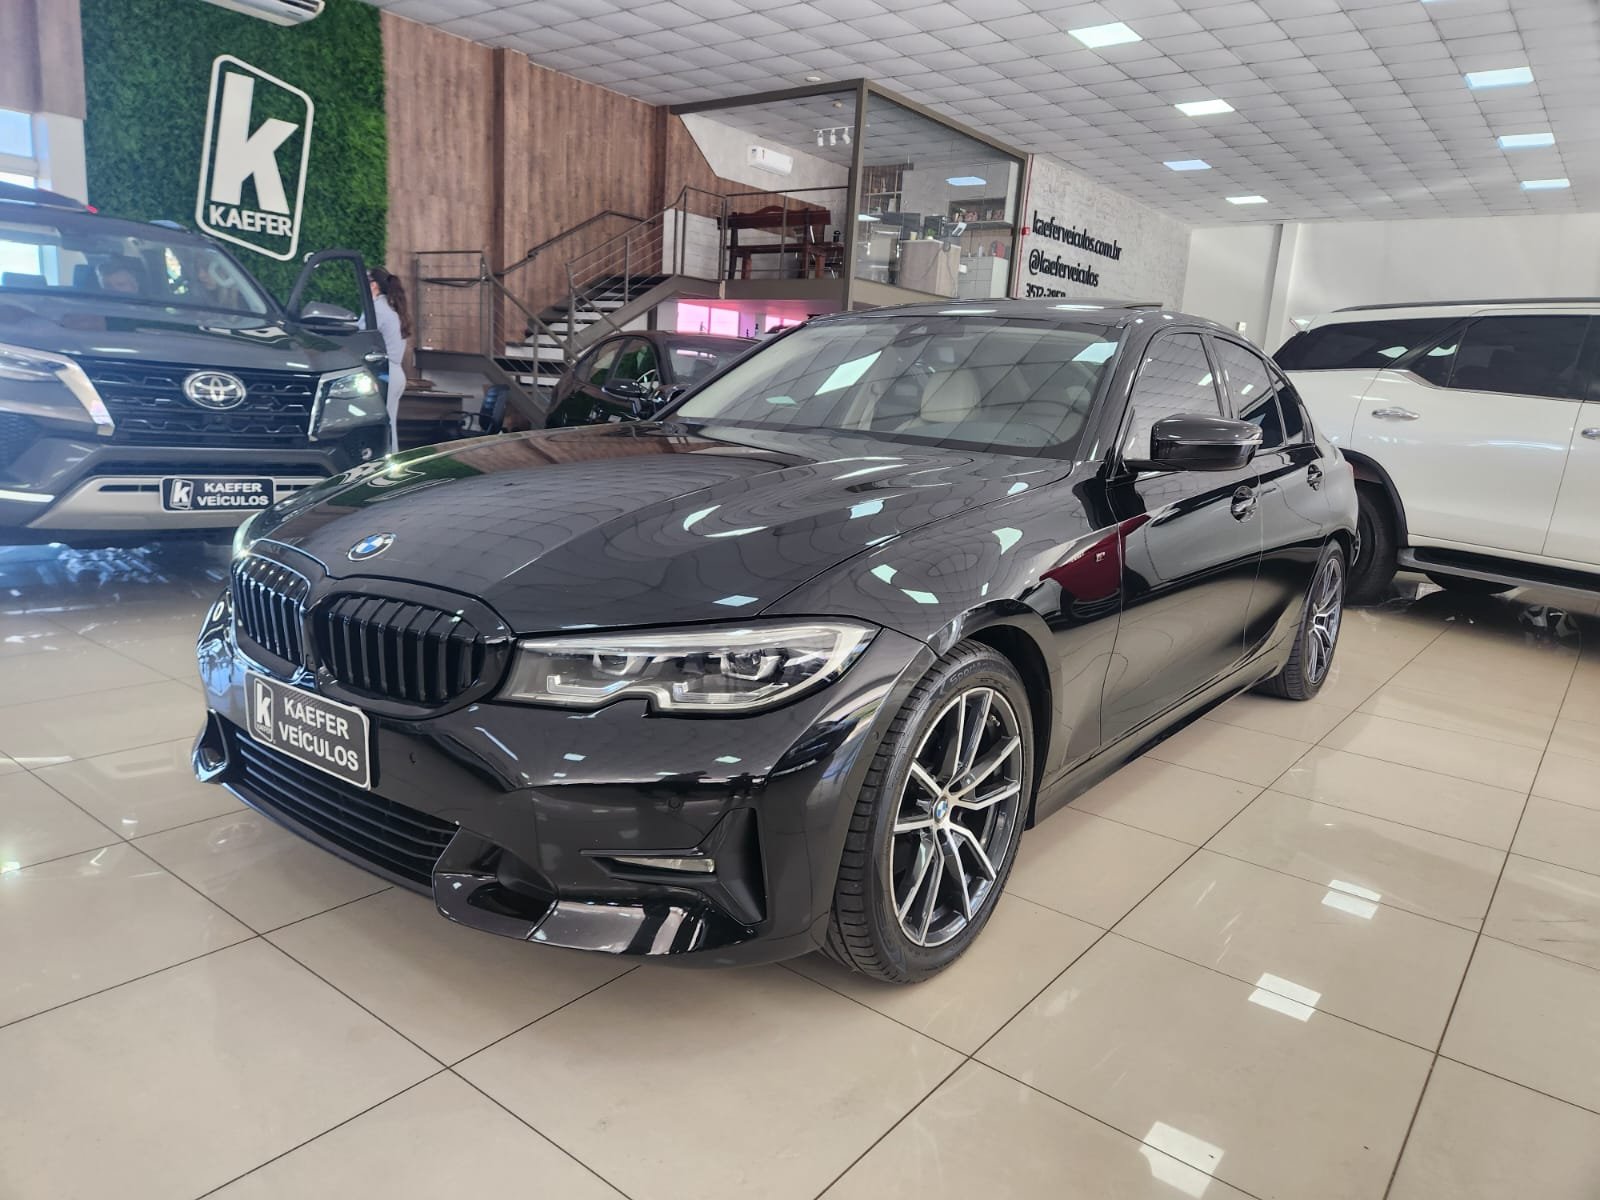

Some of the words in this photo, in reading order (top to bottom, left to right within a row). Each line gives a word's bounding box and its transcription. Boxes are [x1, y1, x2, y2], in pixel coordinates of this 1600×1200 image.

[209, 204, 293, 237] KAEFER
[1033, 210, 1122, 260] kaeferveiculos.com.br
[1029, 249, 1099, 287] @kaeferveiculos
[197, 493, 269, 506] VEÍCULOS
[204, 482, 262, 493] KAEFER
[284, 697, 349, 739] KAEFER
[279, 721, 359, 771] VEÍCULOS
